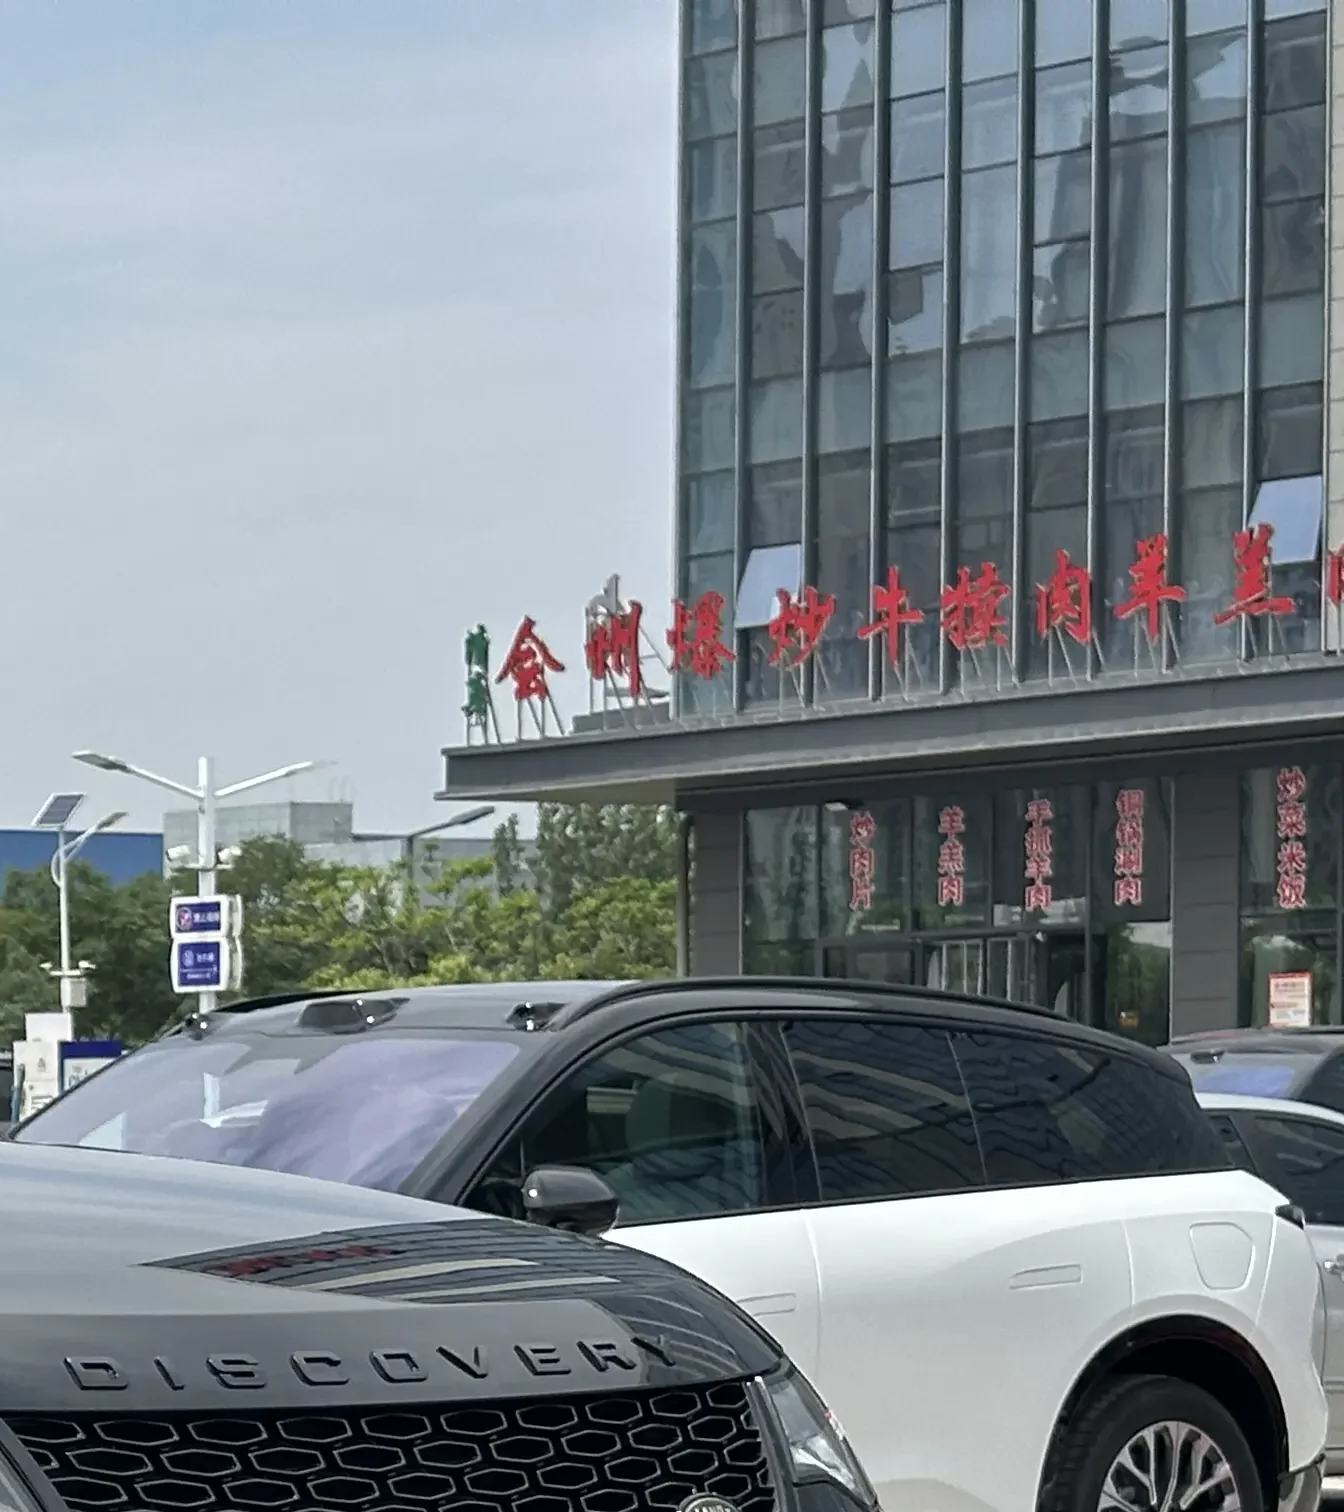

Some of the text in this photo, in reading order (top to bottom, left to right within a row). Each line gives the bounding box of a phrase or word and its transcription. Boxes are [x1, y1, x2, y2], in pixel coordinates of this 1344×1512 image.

[849, 810, 876, 911] 炒肉片
[938, 806, 965, 907] 羊羔肉
[1025, 799, 1053, 912] 手抓羊肉
[1276, 766, 1307, 909] 炒菜米饭
[64, 1333, 674, 1390] DISCOVERY
